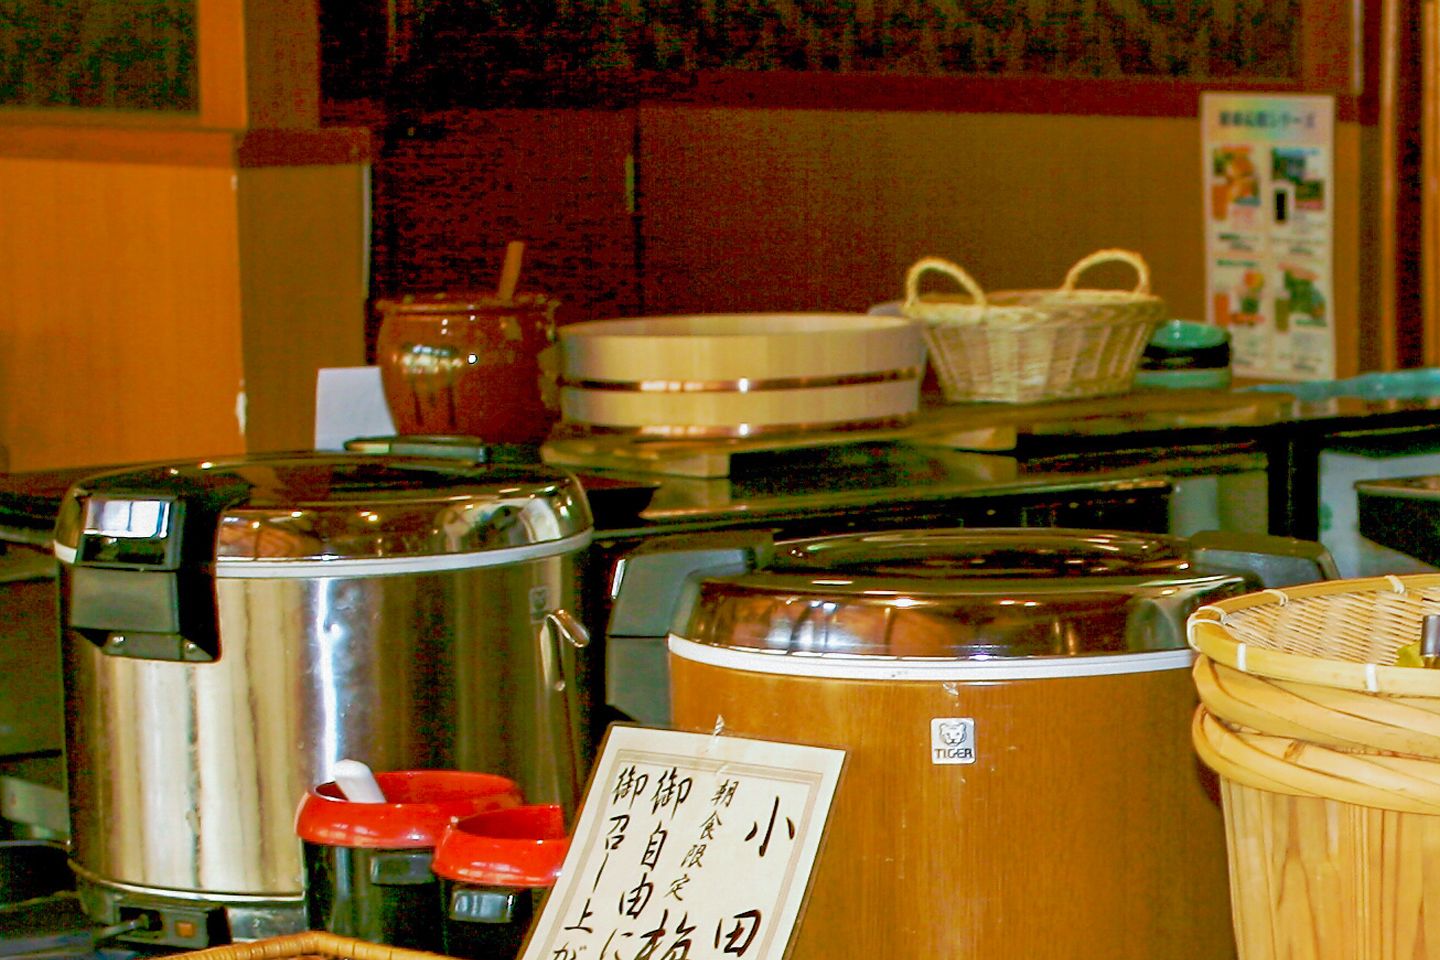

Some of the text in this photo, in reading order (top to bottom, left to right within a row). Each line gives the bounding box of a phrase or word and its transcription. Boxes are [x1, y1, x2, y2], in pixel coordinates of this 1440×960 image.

[933, 747, 974, 759] TIGER
[664, 778, 739, 901] 朝食限定
